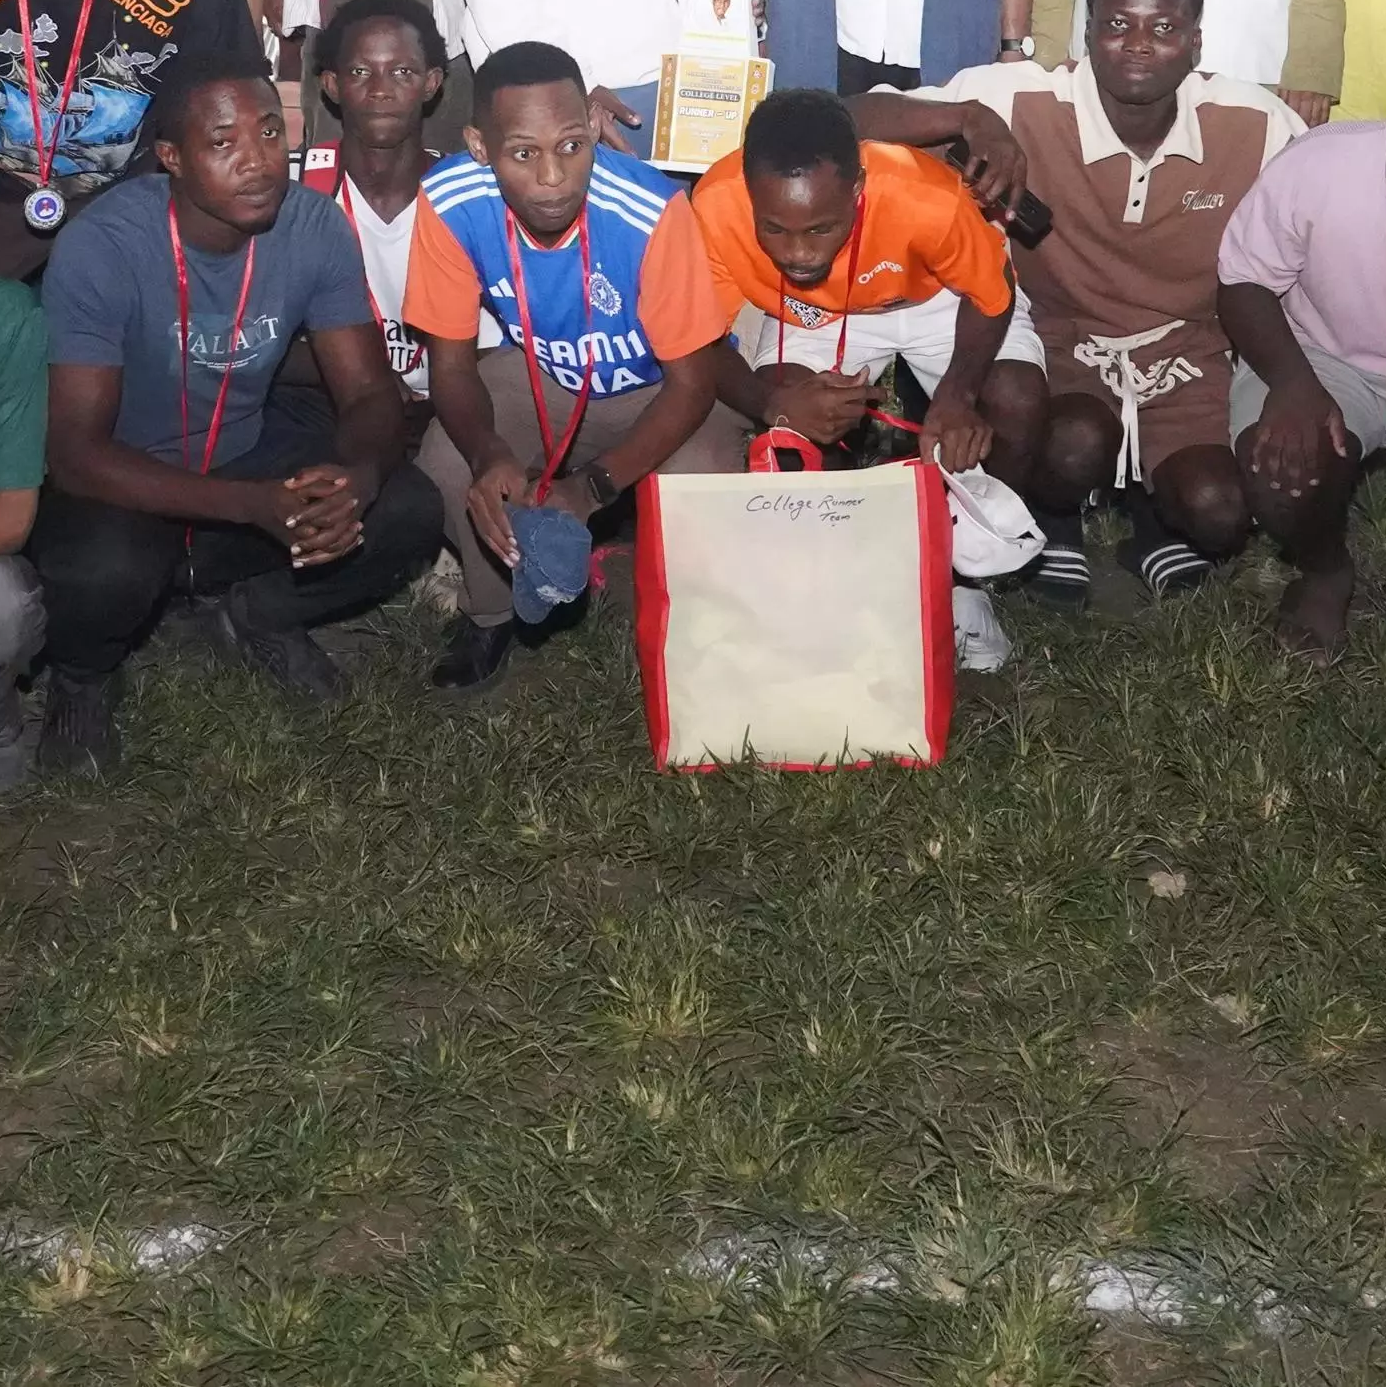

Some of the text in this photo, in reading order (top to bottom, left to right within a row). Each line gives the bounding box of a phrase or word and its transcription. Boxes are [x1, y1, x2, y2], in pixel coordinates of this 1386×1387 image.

[679, 88, 740, 102] COLLEGE LEVEL
[679, 107, 715, 118] RUNNER
[858, 260, 904, 285] Orange
[745, 494, 866, 522] College Runner
[819, 511, 851, 523] Team
